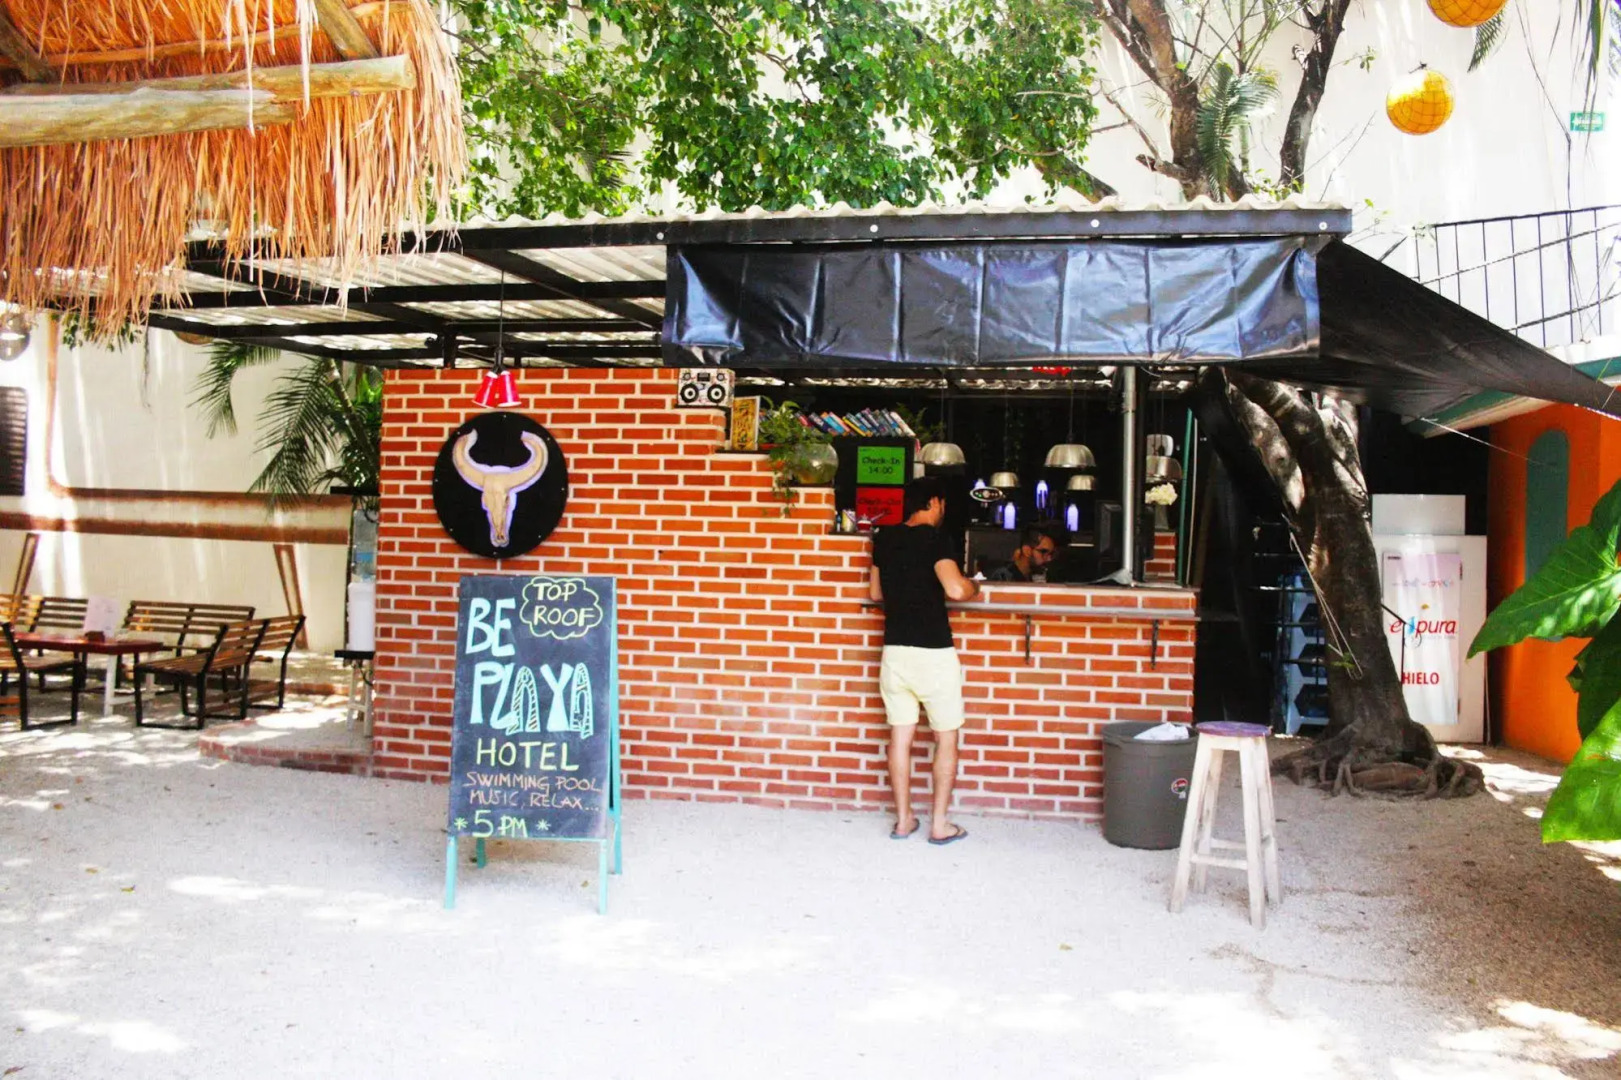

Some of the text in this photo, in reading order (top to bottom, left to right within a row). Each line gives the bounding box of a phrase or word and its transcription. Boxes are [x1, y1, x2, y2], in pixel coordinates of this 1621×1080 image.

[533, 582, 577, 602] TOP
[465, 597, 516, 657] BE
[534, 605, 595, 627] ROOF
[1402, 672, 1440, 685] HIELO
[470, 661, 594, 739] PLAYA
[476, 738, 579, 771] HOTEL
[463, 771, 602, 796] SWIMMING POOL
